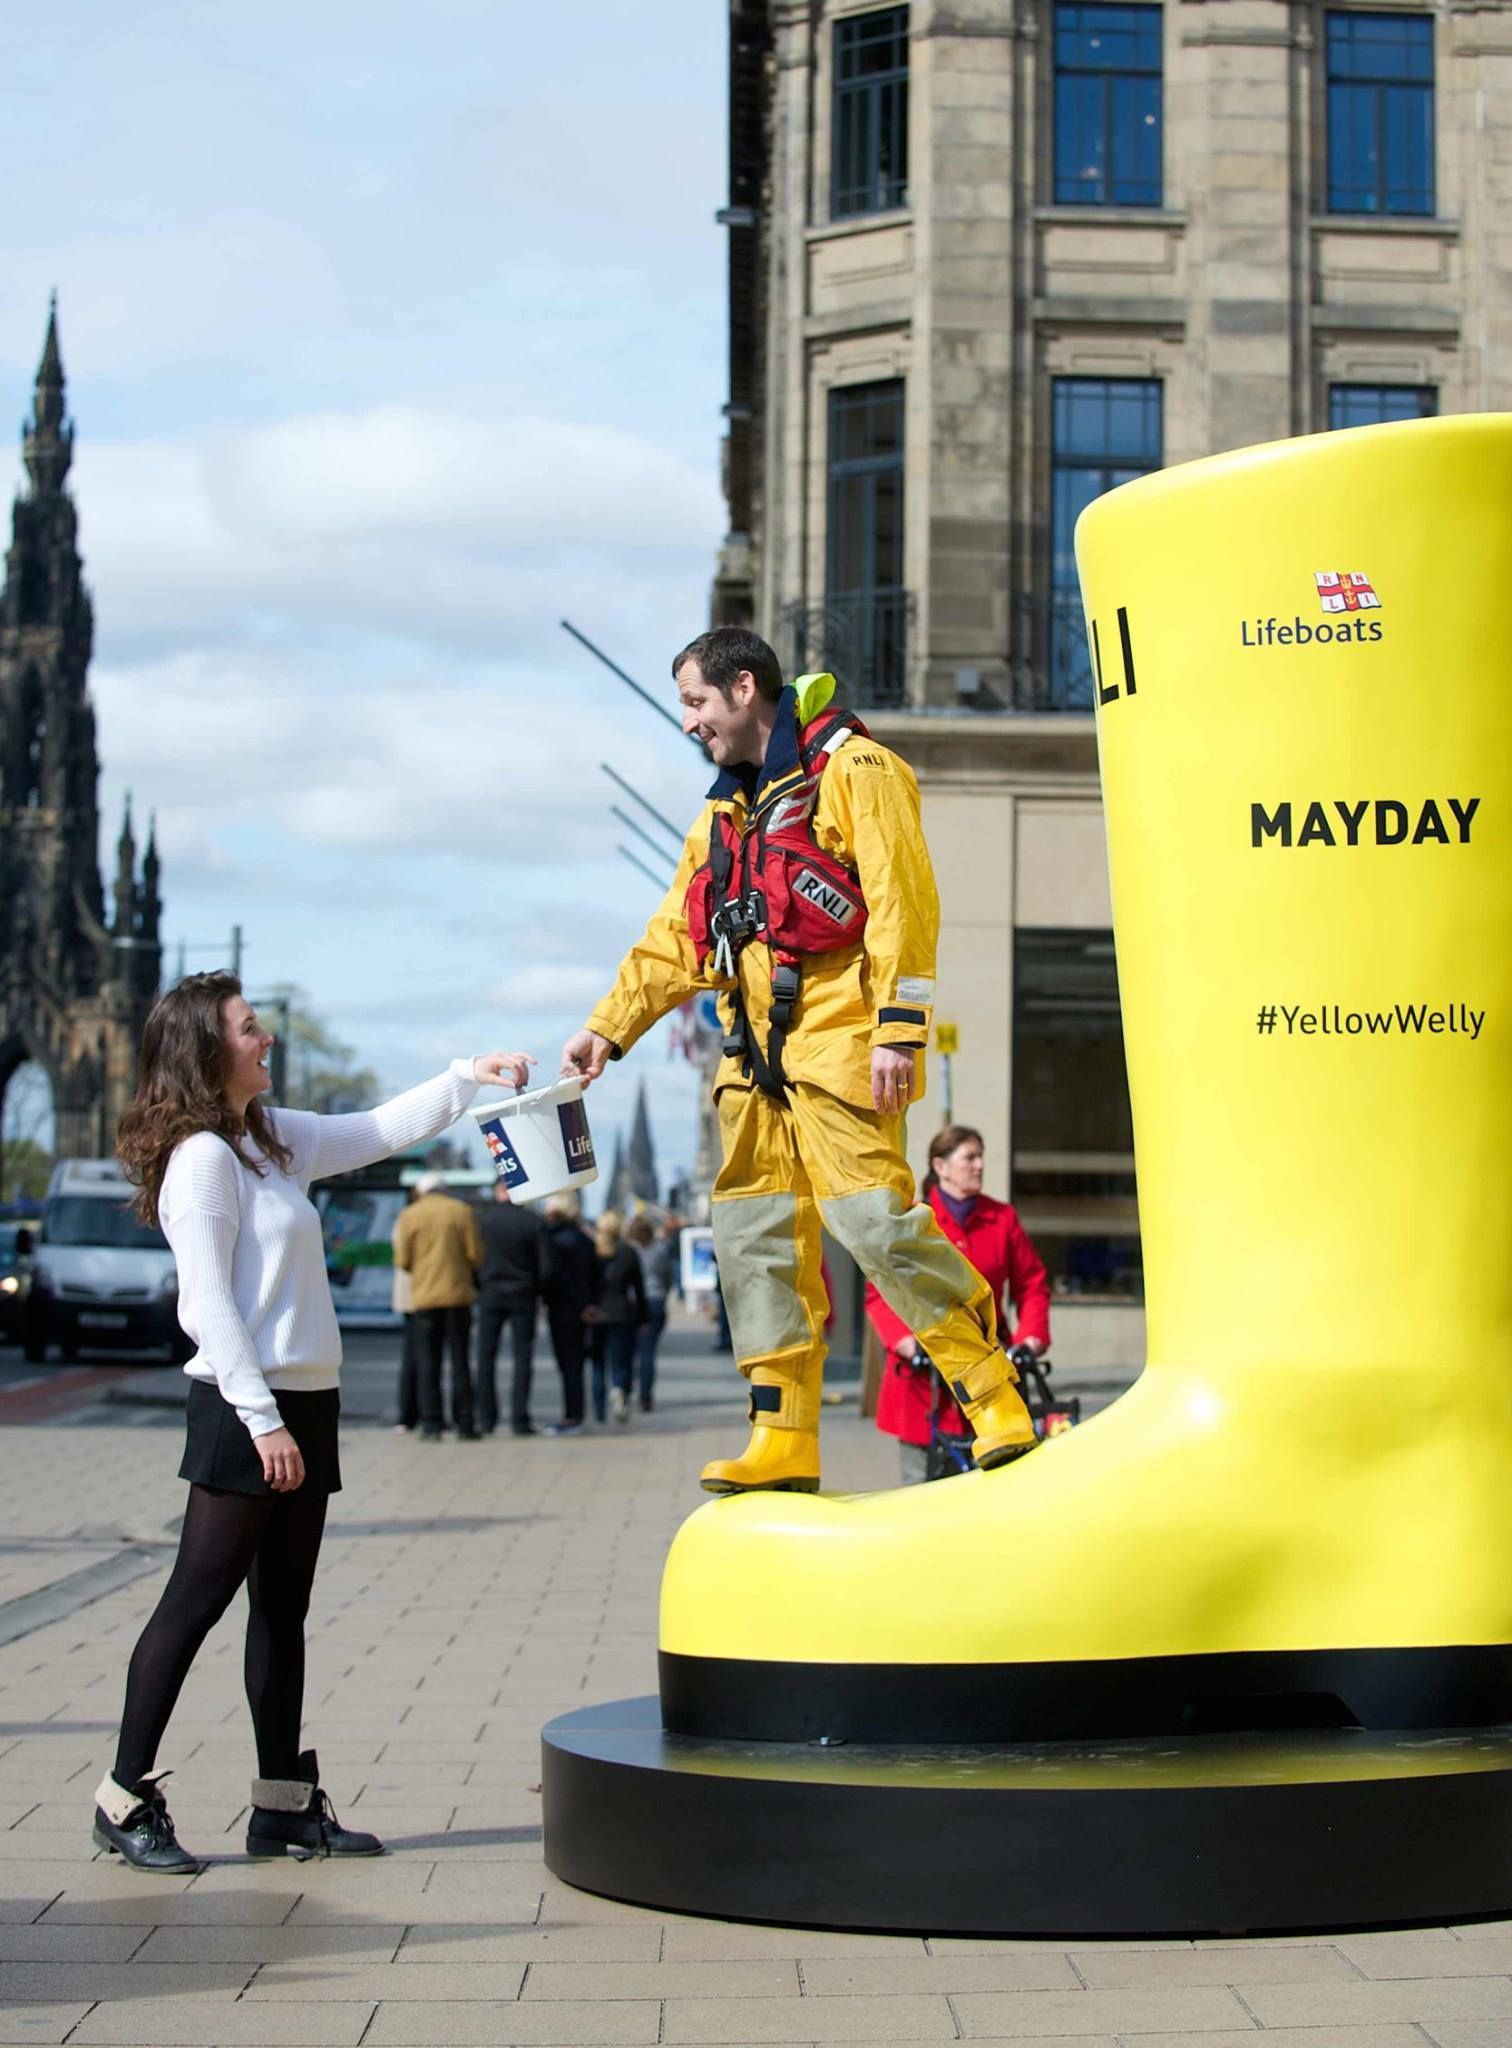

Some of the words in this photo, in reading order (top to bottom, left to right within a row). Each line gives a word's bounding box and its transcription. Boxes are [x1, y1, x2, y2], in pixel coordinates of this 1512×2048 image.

[1241, 617, 1383, 647] Lifeboats
[1089, 606, 1137, 707] LI
[852, 753, 885, 768] RNLI
[1250, 798, 1481, 848] MAYDAY
[801, 877, 850, 921] RNLI
[1256, 1004, 1486, 1040] #YellowWelly
